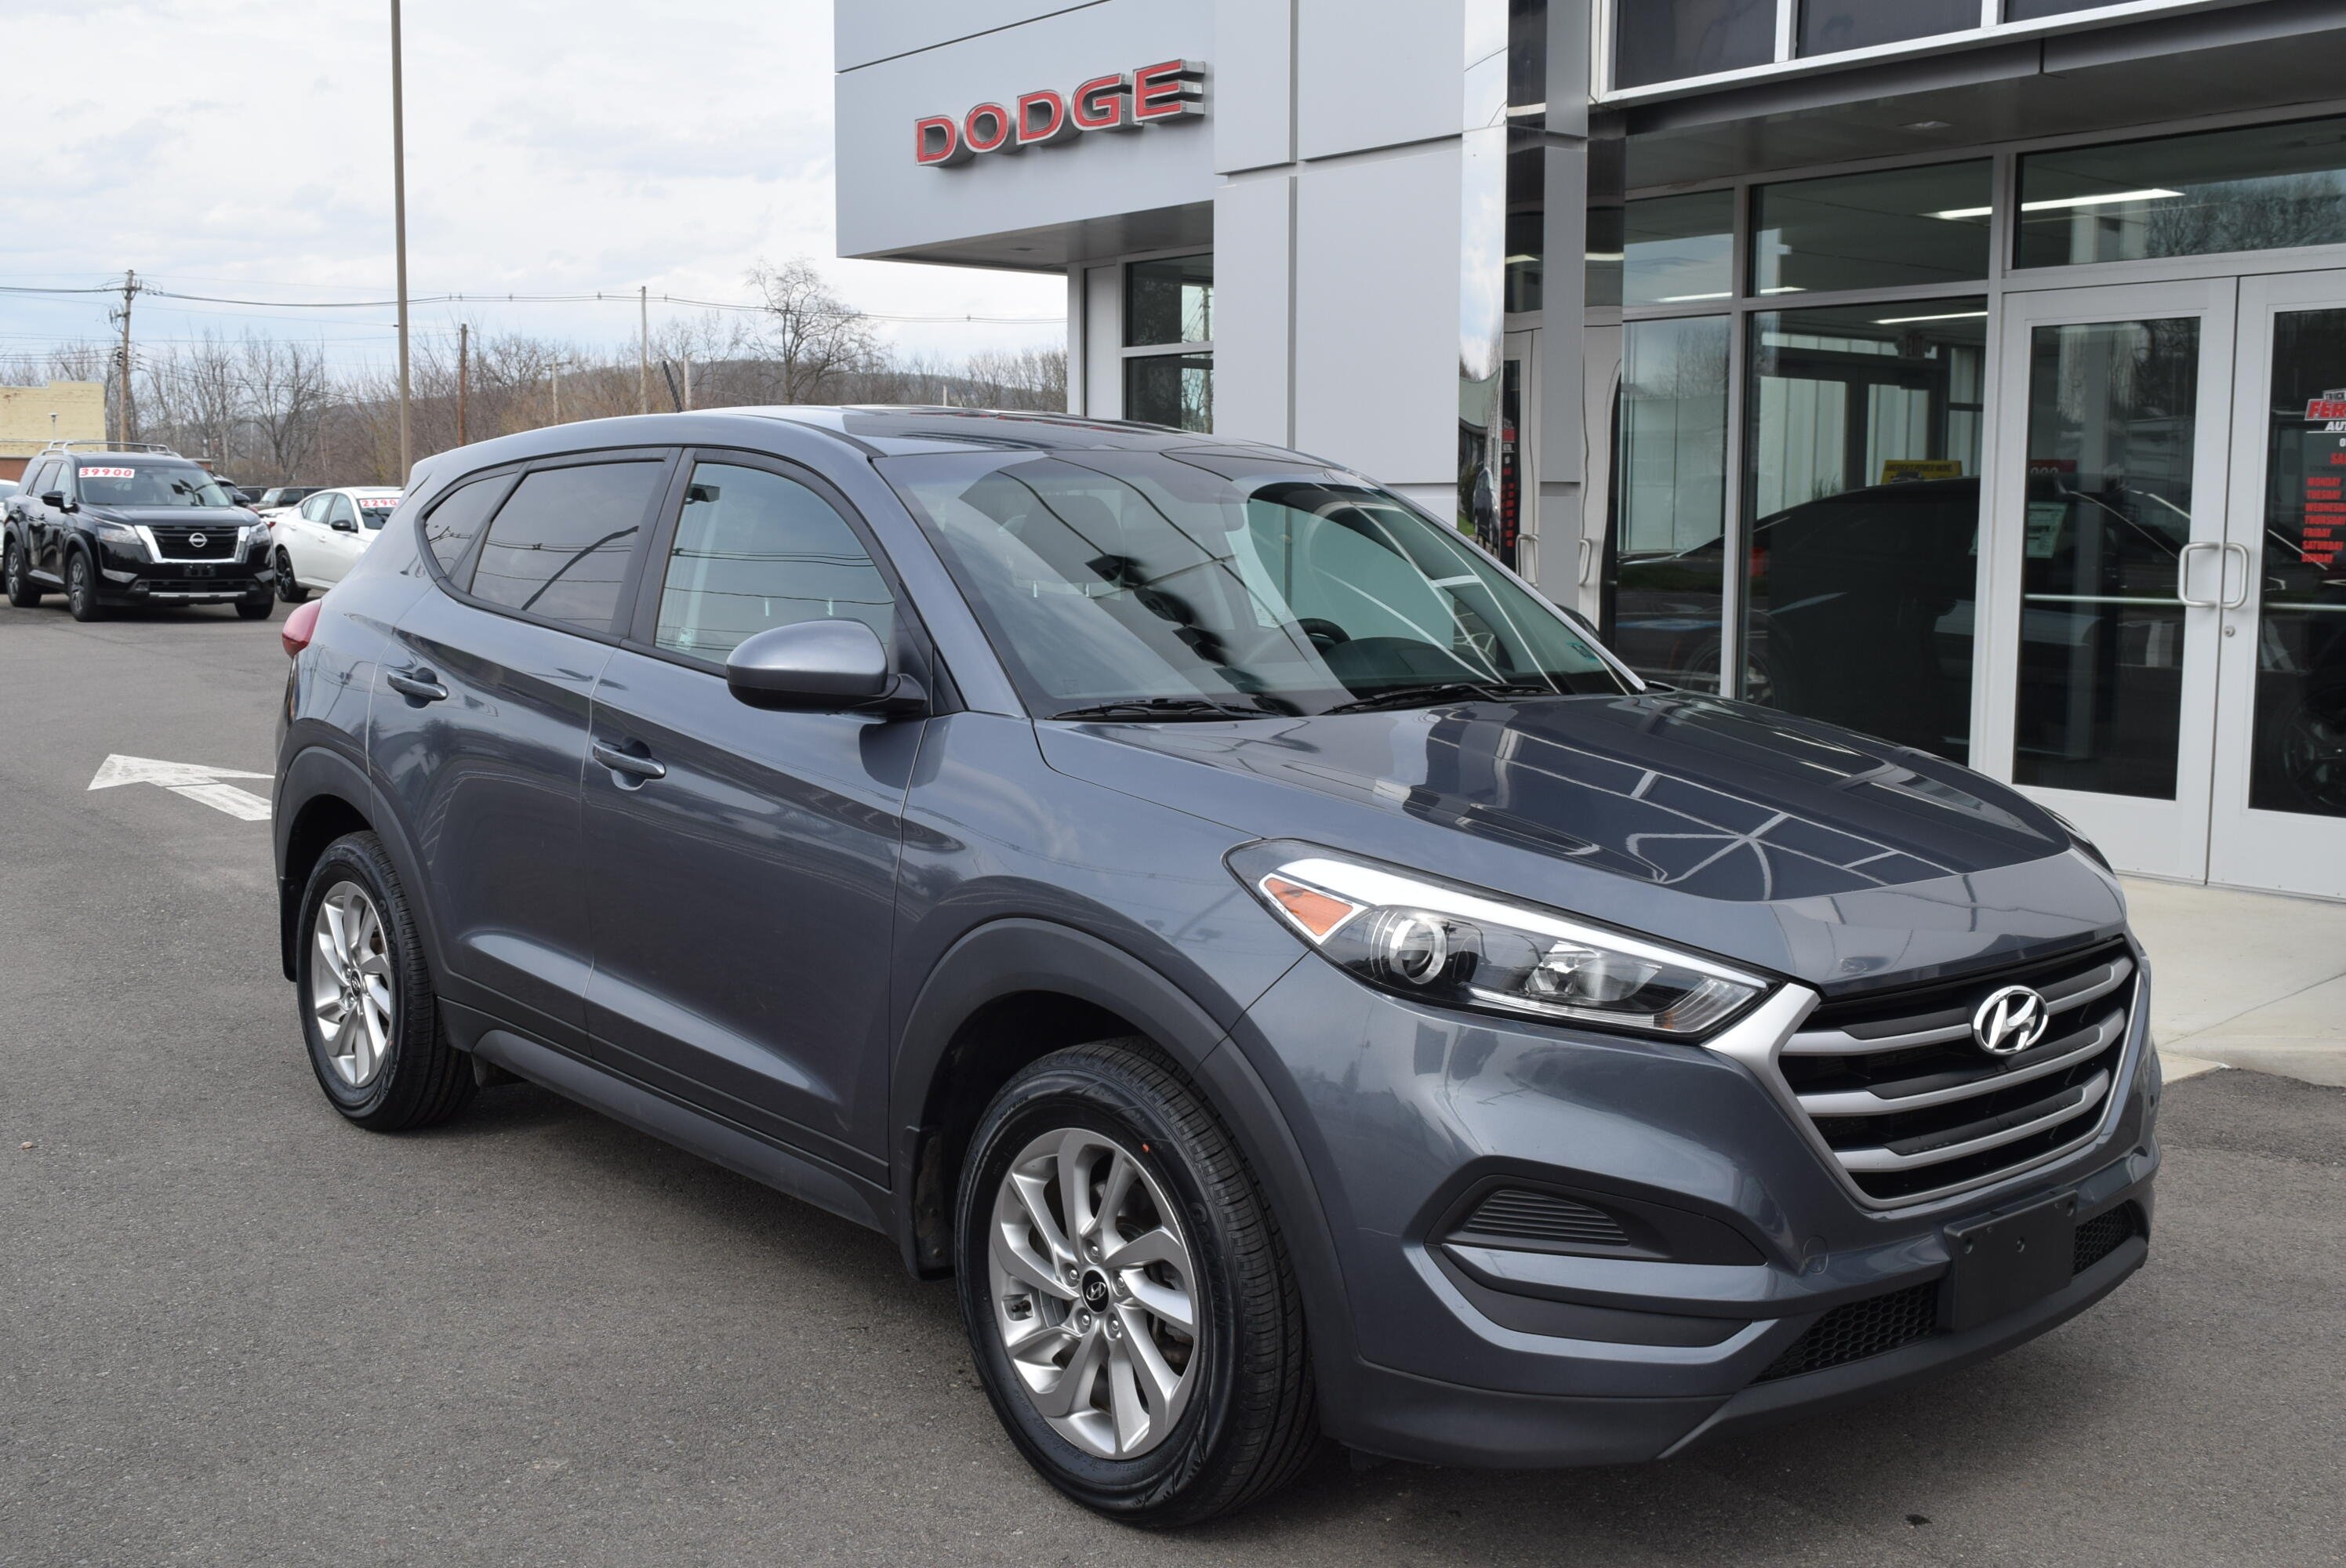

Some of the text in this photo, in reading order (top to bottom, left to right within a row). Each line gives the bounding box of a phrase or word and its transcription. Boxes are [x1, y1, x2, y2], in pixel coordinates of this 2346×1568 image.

[915, 59, 1186, 165] DODGE
[80, 468, 133, 477] 39900
[361, 499, 398, 507] 2290
[2302, 540, 2344, 550] SATURDAY
